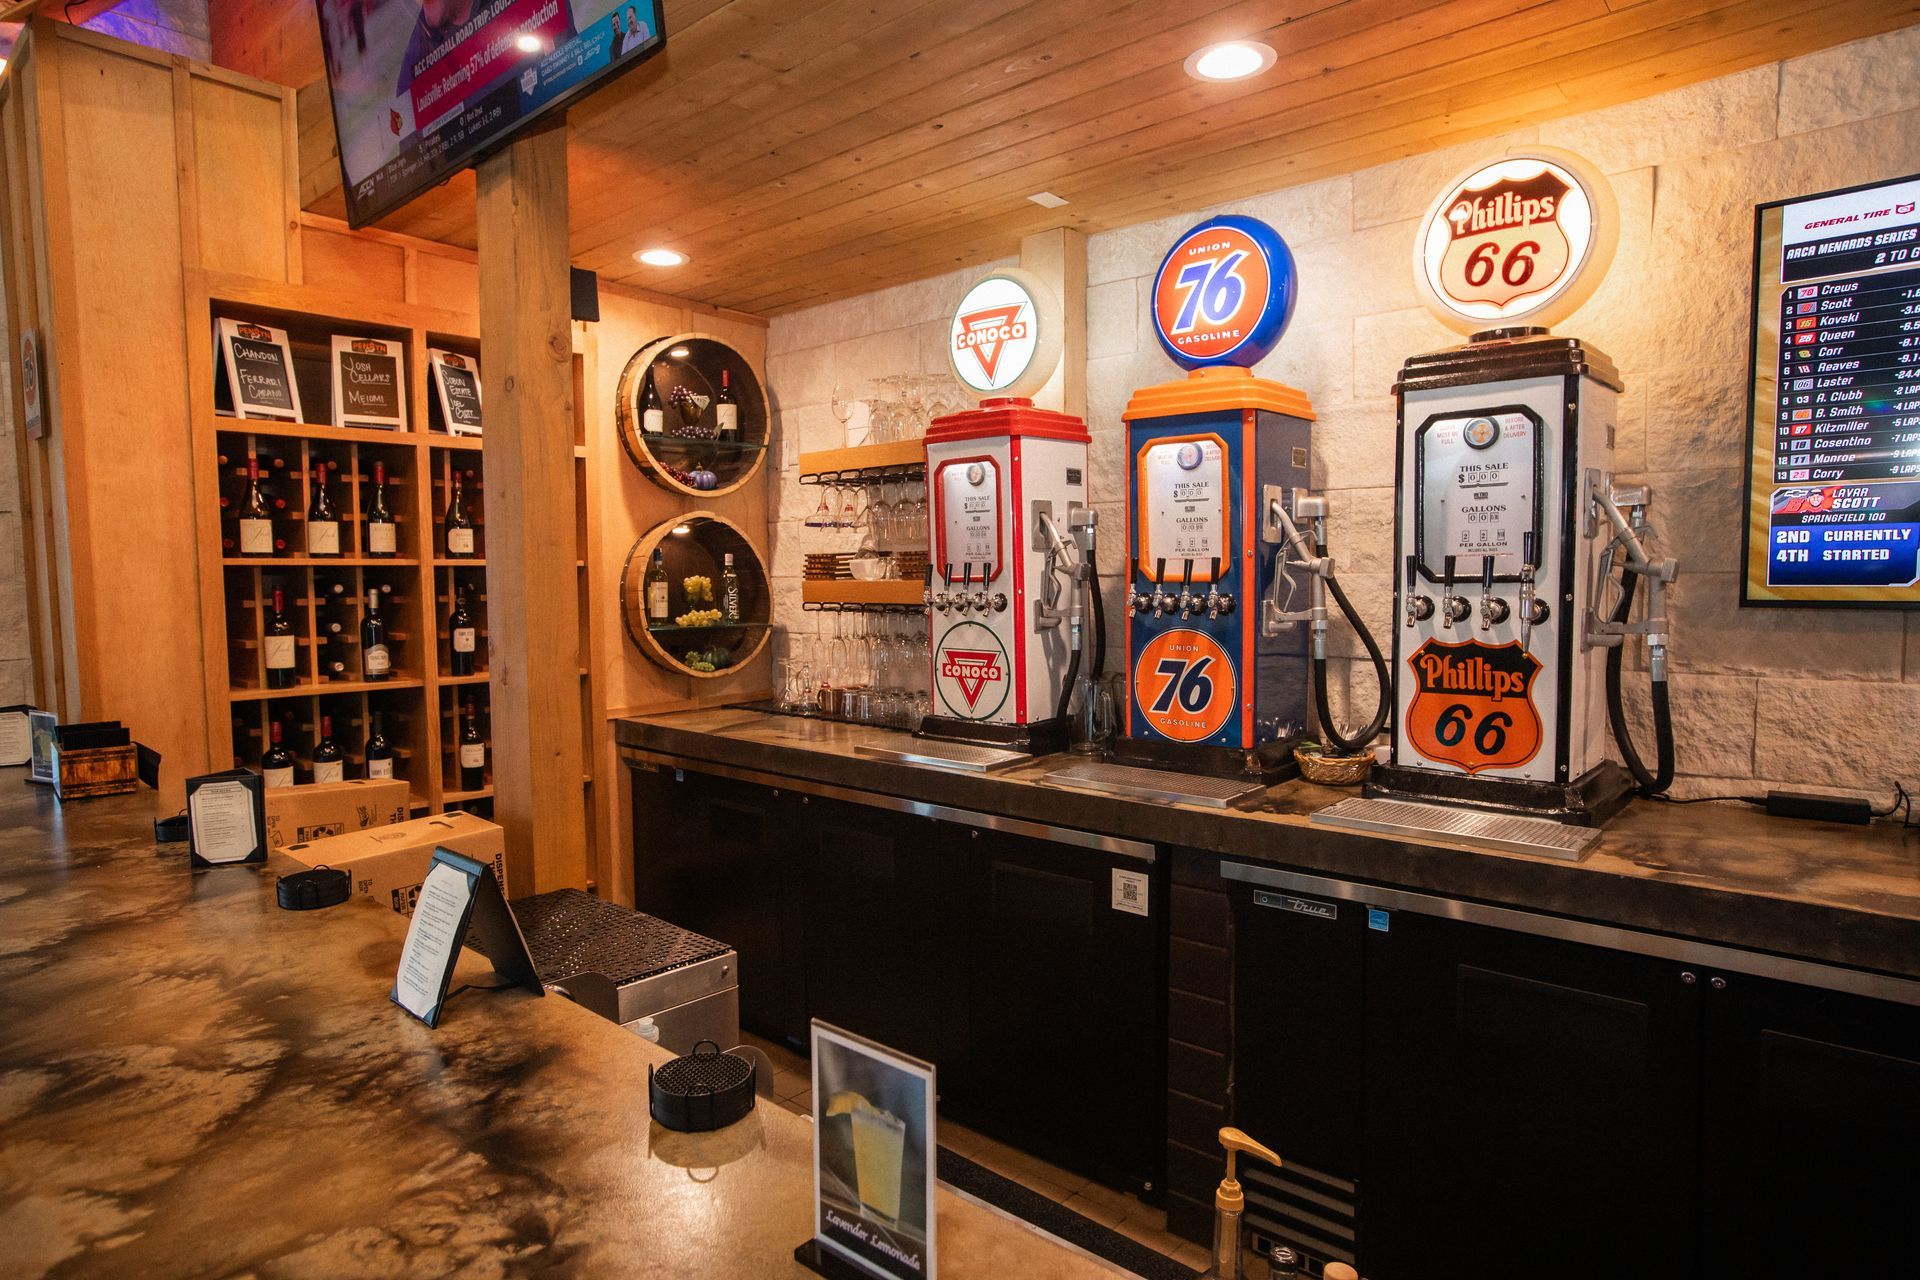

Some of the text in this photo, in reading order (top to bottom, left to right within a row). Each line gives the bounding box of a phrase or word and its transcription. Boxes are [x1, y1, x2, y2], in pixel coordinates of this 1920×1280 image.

[414, 58, 427, 77] ACC
[426, 36, 458, 68] FOOTBALL
[456, 22, 474, 45] ROAD
[416, 84, 444, 112] Louisville:
[442, 64, 471, 94] Returning
[470, 52, 484, 74] 57%
[484, 43, 492, 64] of
[1449, 192, 1554, 235] Phillips
[1804, 214, 1860, 230] GENERAL
[1863, 208, 1891, 220] TIRE
[1189, 242, 1231, 256] UNION
[1786, 228, 1918, 260] ARCA MENARDS SERIES
[1464, 240, 1540, 286] 66
[1874, 252, 1886, 264] 2
[1890, 249, 1908, 262] TO
[1170, 249, 1250, 336] 76
[1788, 290, 1792, 299] 1
[1822, 282, 1858, 296] Crews
[1786, 306, 1793, 315] 2
[1820, 298, 1852, 311] Scott
[1785, 312, 1860, 330] 3 Kovski
[958, 324, 1024, 348] CONOCO
[1178, 329, 1240, 344] GASOLINE
[1785, 336, 1791, 344] 4
[1819, 330, 1855, 343] Queen
[234, 343, 278, 361] CHANDON
[1784, 352, 1791, 360] 5
[1818, 346, 1844, 358] Corr
[1784, 367, 1790, 375] 6
[1818, 360, 1860, 373] Reaves
[240, 369, 281, 386] FERRARI
[1783, 382, 1789, 390] 7
[1817, 375, 1854, 388] Laster
[1782, 390, 1862, 405] 8 03 A. Clubb
[1894, 385, 1920, 395] -2 LAP
[1782, 412, 1788, 420] 9
[1816, 409, 1826, 418] B.
[1830, 406, 1863, 418] Smith
[1904, 401, 1920, 410] LAP
[1779, 422, 1869, 435] 10 Kitzmiller
[1892, 417, 1920, 426] -5 LAP
[1780, 437, 1871, 450] 11 Cosentino
[1891, 434, 1900, 442] -7
[1778, 457, 1788, 465] 12
[1814, 454, 1856, 464] Monroe
[1890, 450, 1900, 458] -9
[1778, 471, 1787, 480] 13
[1813, 469, 1844, 480] Corry
[1890, 466, 1899, 474] -9
[1832, 488, 1869, 498] LAVAR
[1462, 505, 1506, 513] GALLONS
[1832, 497, 1880, 508] SCOTT
[1801, 512, 1886, 523] SPRINGFIELD 100
[1776, 528, 1911, 543] 2ND CURRENTLY
[1776, 549, 1890, 562] 4TH STARTED
[945, 664, 998, 679] CONOCO
[1420, 653, 1524, 702] Phillips
[1148, 655, 1217, 714] 76
[1160, 718, 1207, 729] GASOLINE
[1435, 704, 1513, 756] 66
[826, 1210, 920, 1271] Lavender Lemonade
